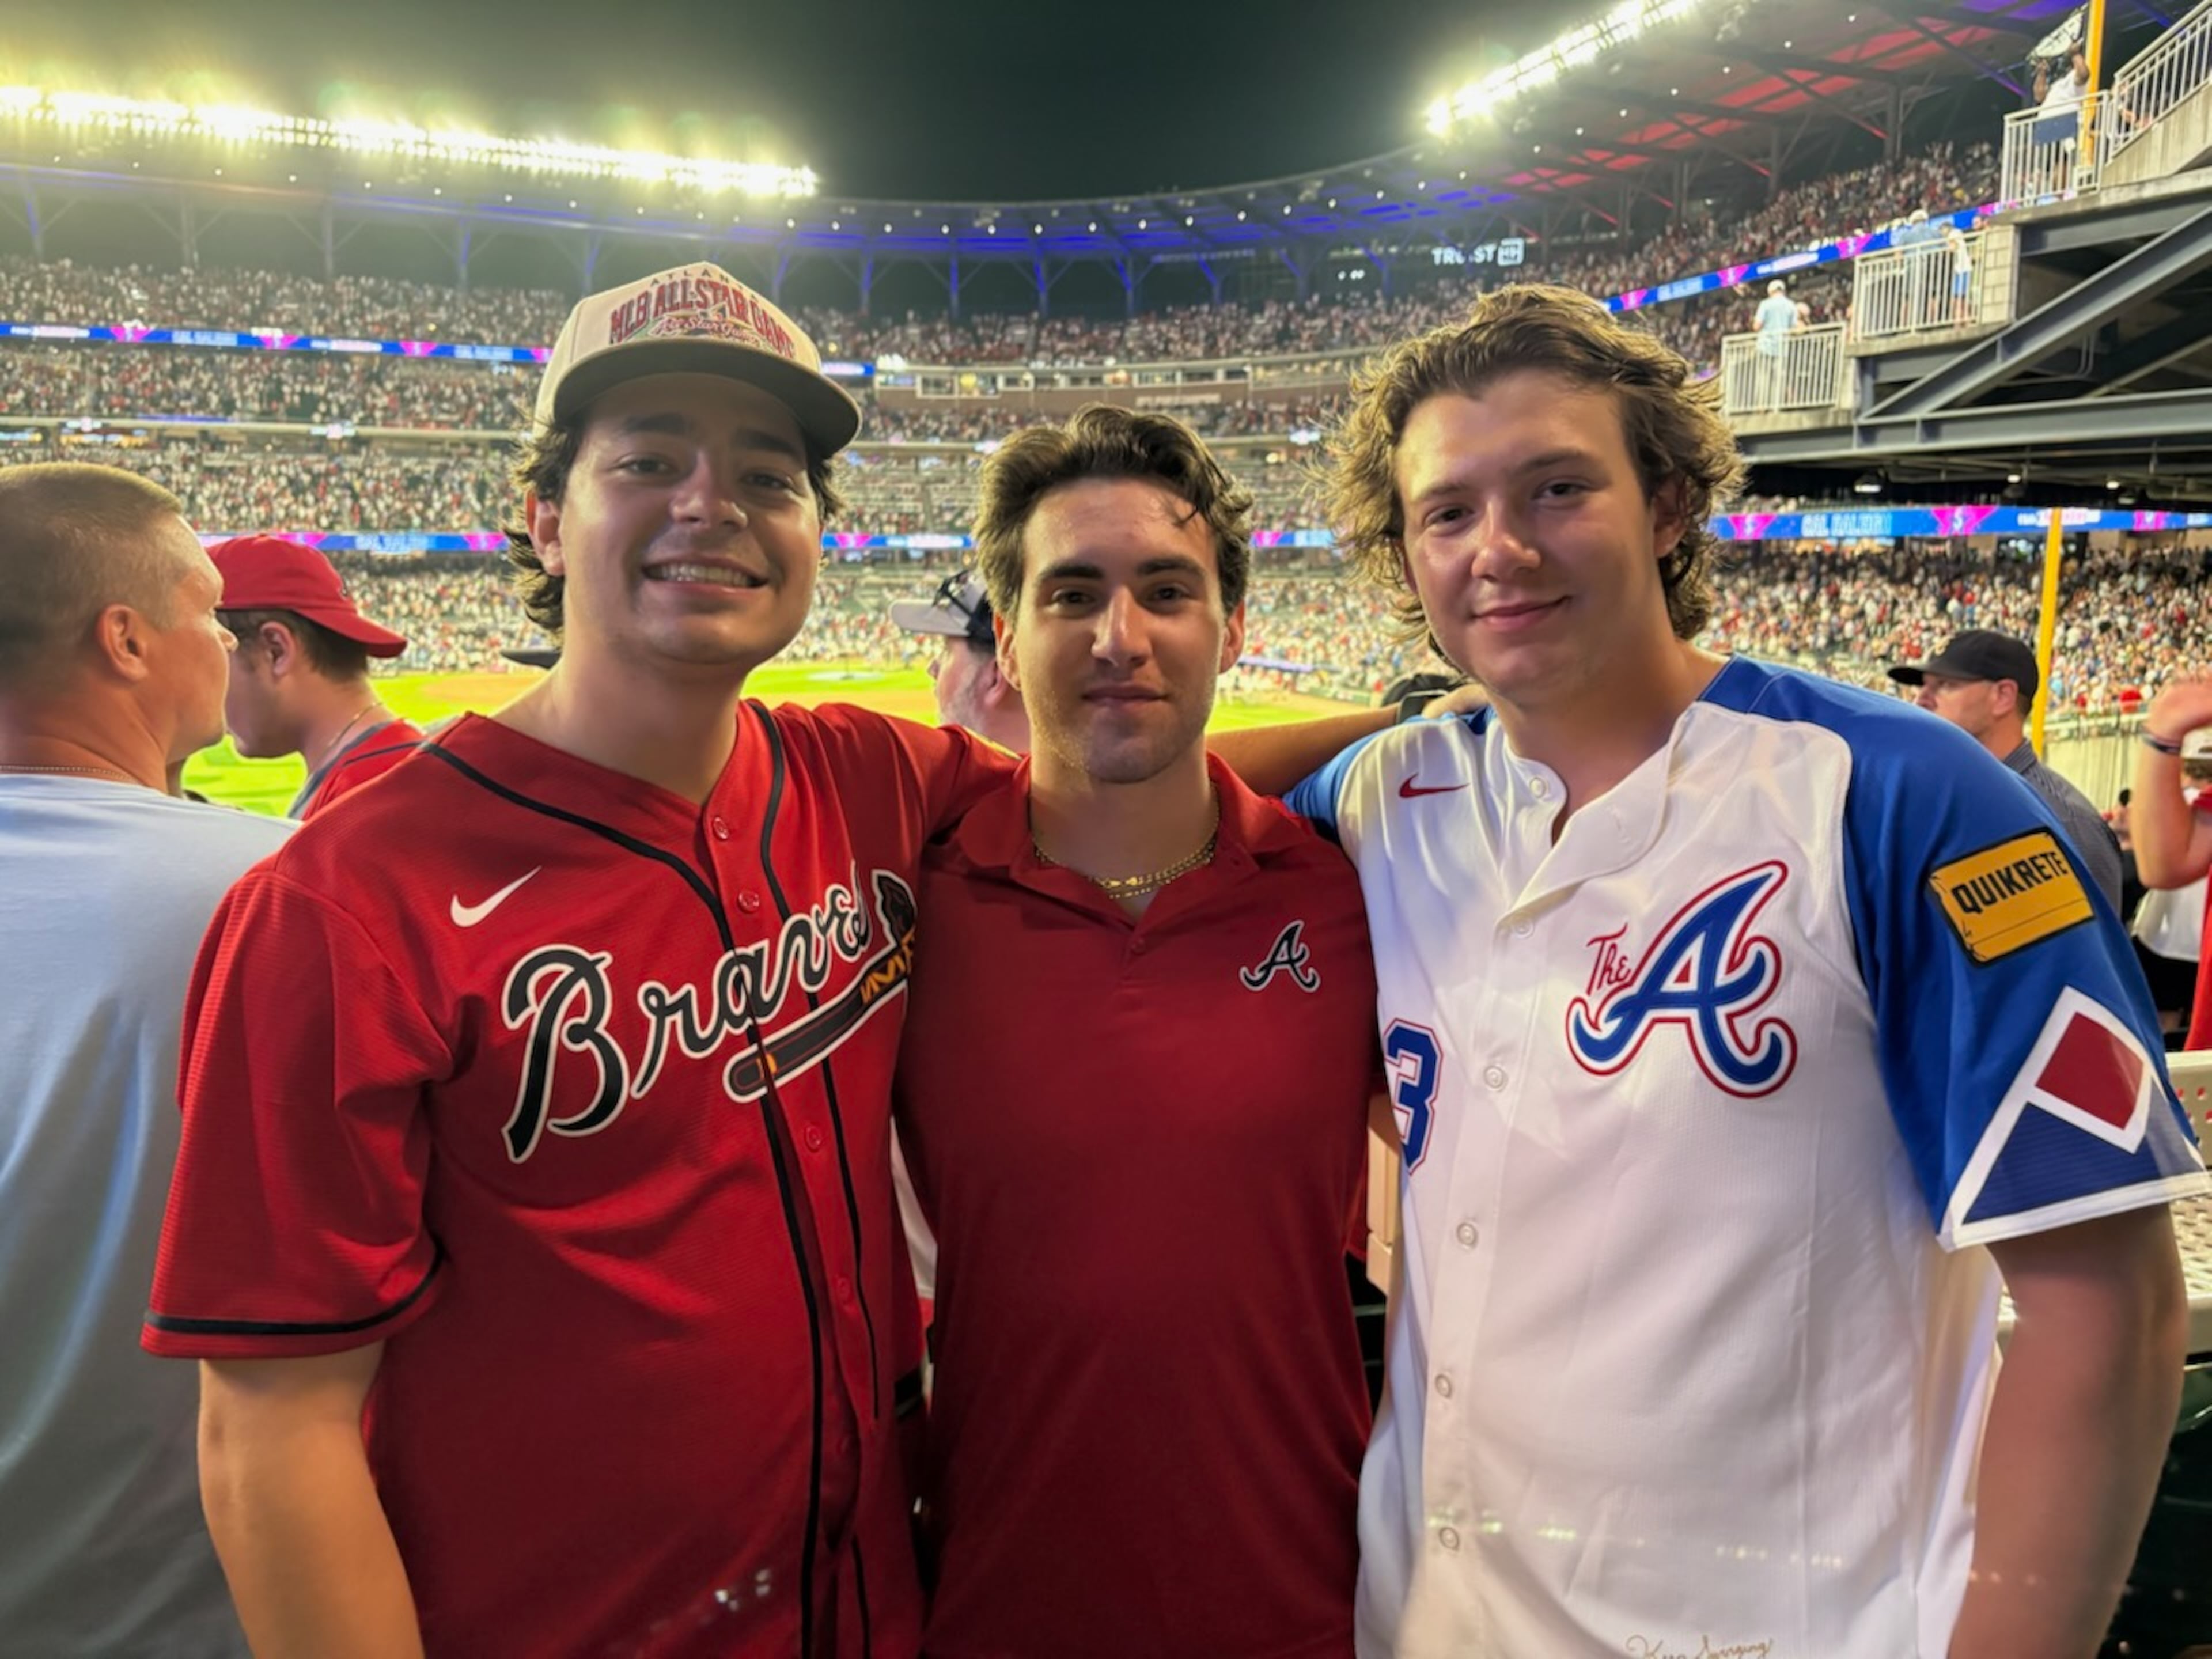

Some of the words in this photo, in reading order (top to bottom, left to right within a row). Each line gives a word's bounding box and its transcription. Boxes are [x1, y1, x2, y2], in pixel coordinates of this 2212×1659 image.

[609, 290, 651, 345] MLB
[749, 298, 794, 359] GAME
[1950, 851, 2068, 915] QUIKRETE
[1239, 919, 1321, 993] A
[1565, 859, 1798, 1099] A
[1586, 922, 1632, 996] The
[501, 860, 872, 1164] Braves
